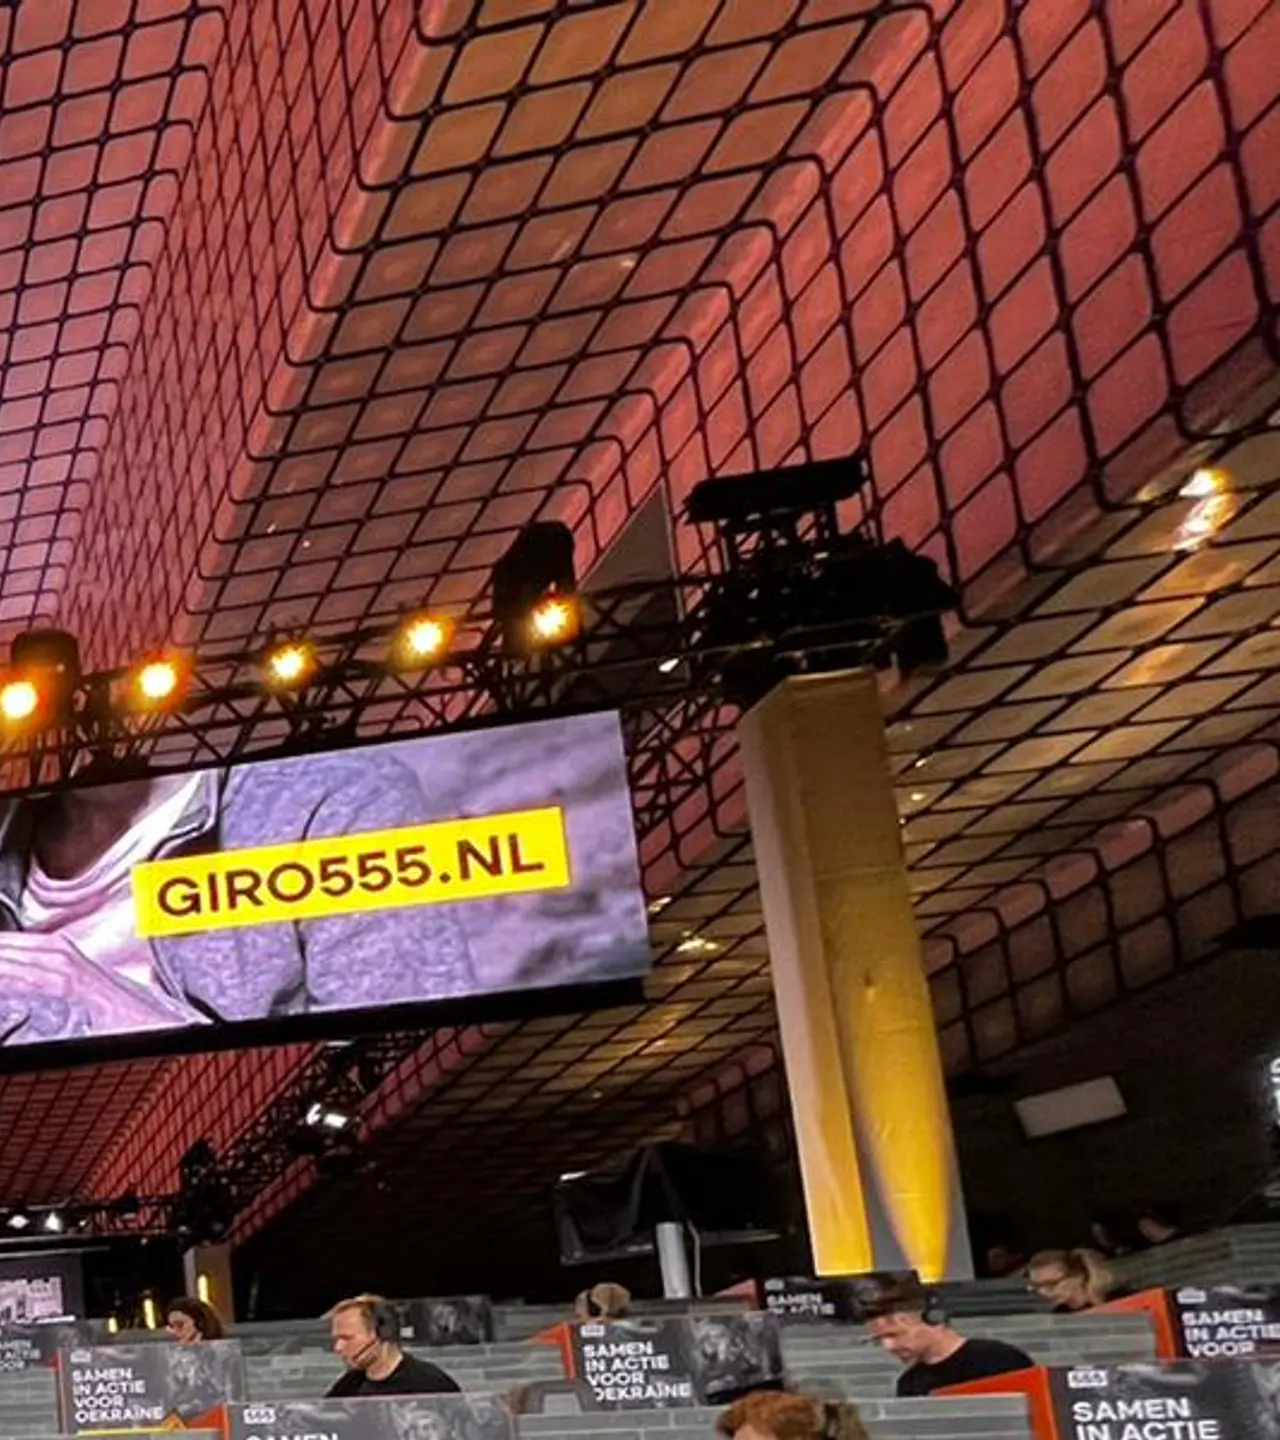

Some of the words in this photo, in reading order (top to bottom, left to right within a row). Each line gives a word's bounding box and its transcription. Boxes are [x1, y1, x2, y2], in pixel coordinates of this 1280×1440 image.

[157, 833, 544, 916] GIRO555.NL
[1182, 1309, 1263, 1326] SAMEN
[1184, 1328, 1209, 1341] IN
[583, 1341, 653, 1358] SAMEN
[611, 1354, 669, 1371] ACTIE
[73, 1368, 133, 1382] SAMEN
[1073, 1397, 1191, 1422] SAMEN
